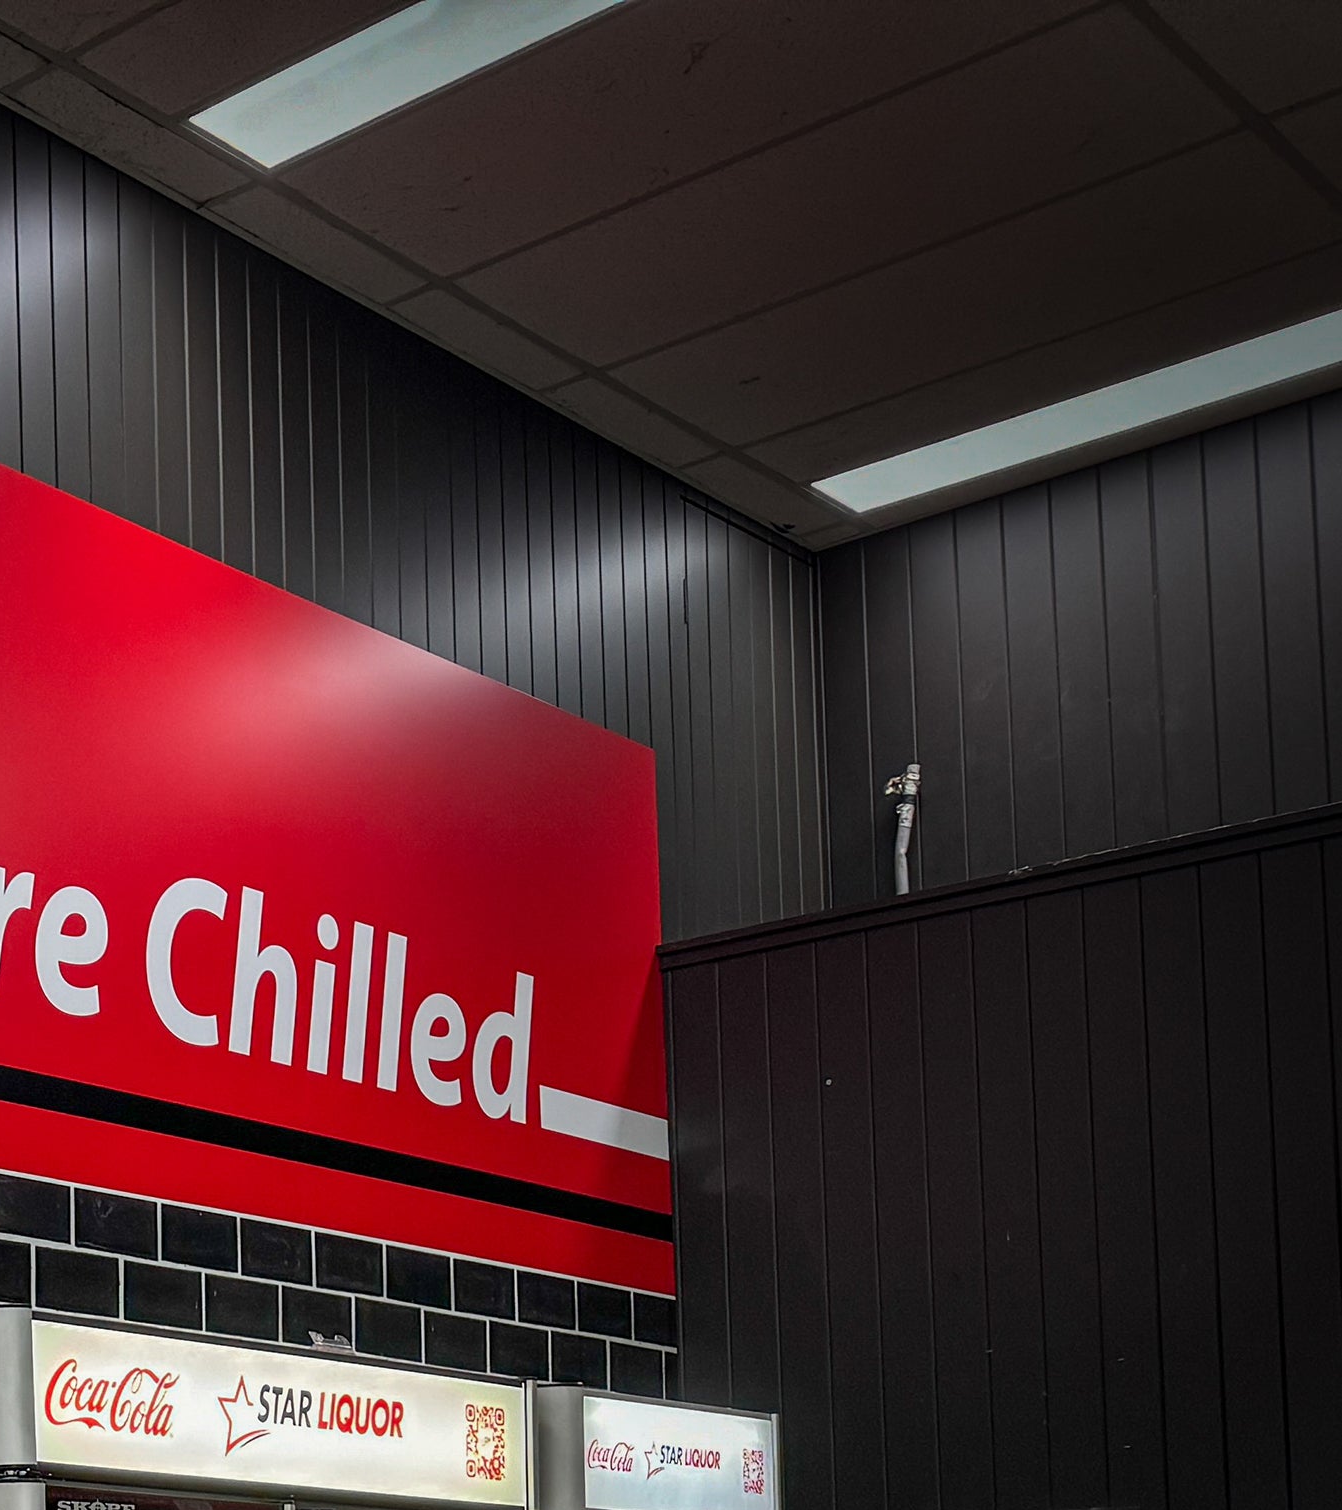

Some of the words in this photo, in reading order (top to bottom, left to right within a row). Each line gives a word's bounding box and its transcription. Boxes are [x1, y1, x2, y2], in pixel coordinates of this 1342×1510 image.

[143, 878, 534, 1125] Chilled
[258, 1385, 312, 1428] STAR
[317, 1394, 404, 1438] LIQUOR
[660, 1446, 682, 1465] STAR
[685, 1449, 720, 1470] LIQUOR
